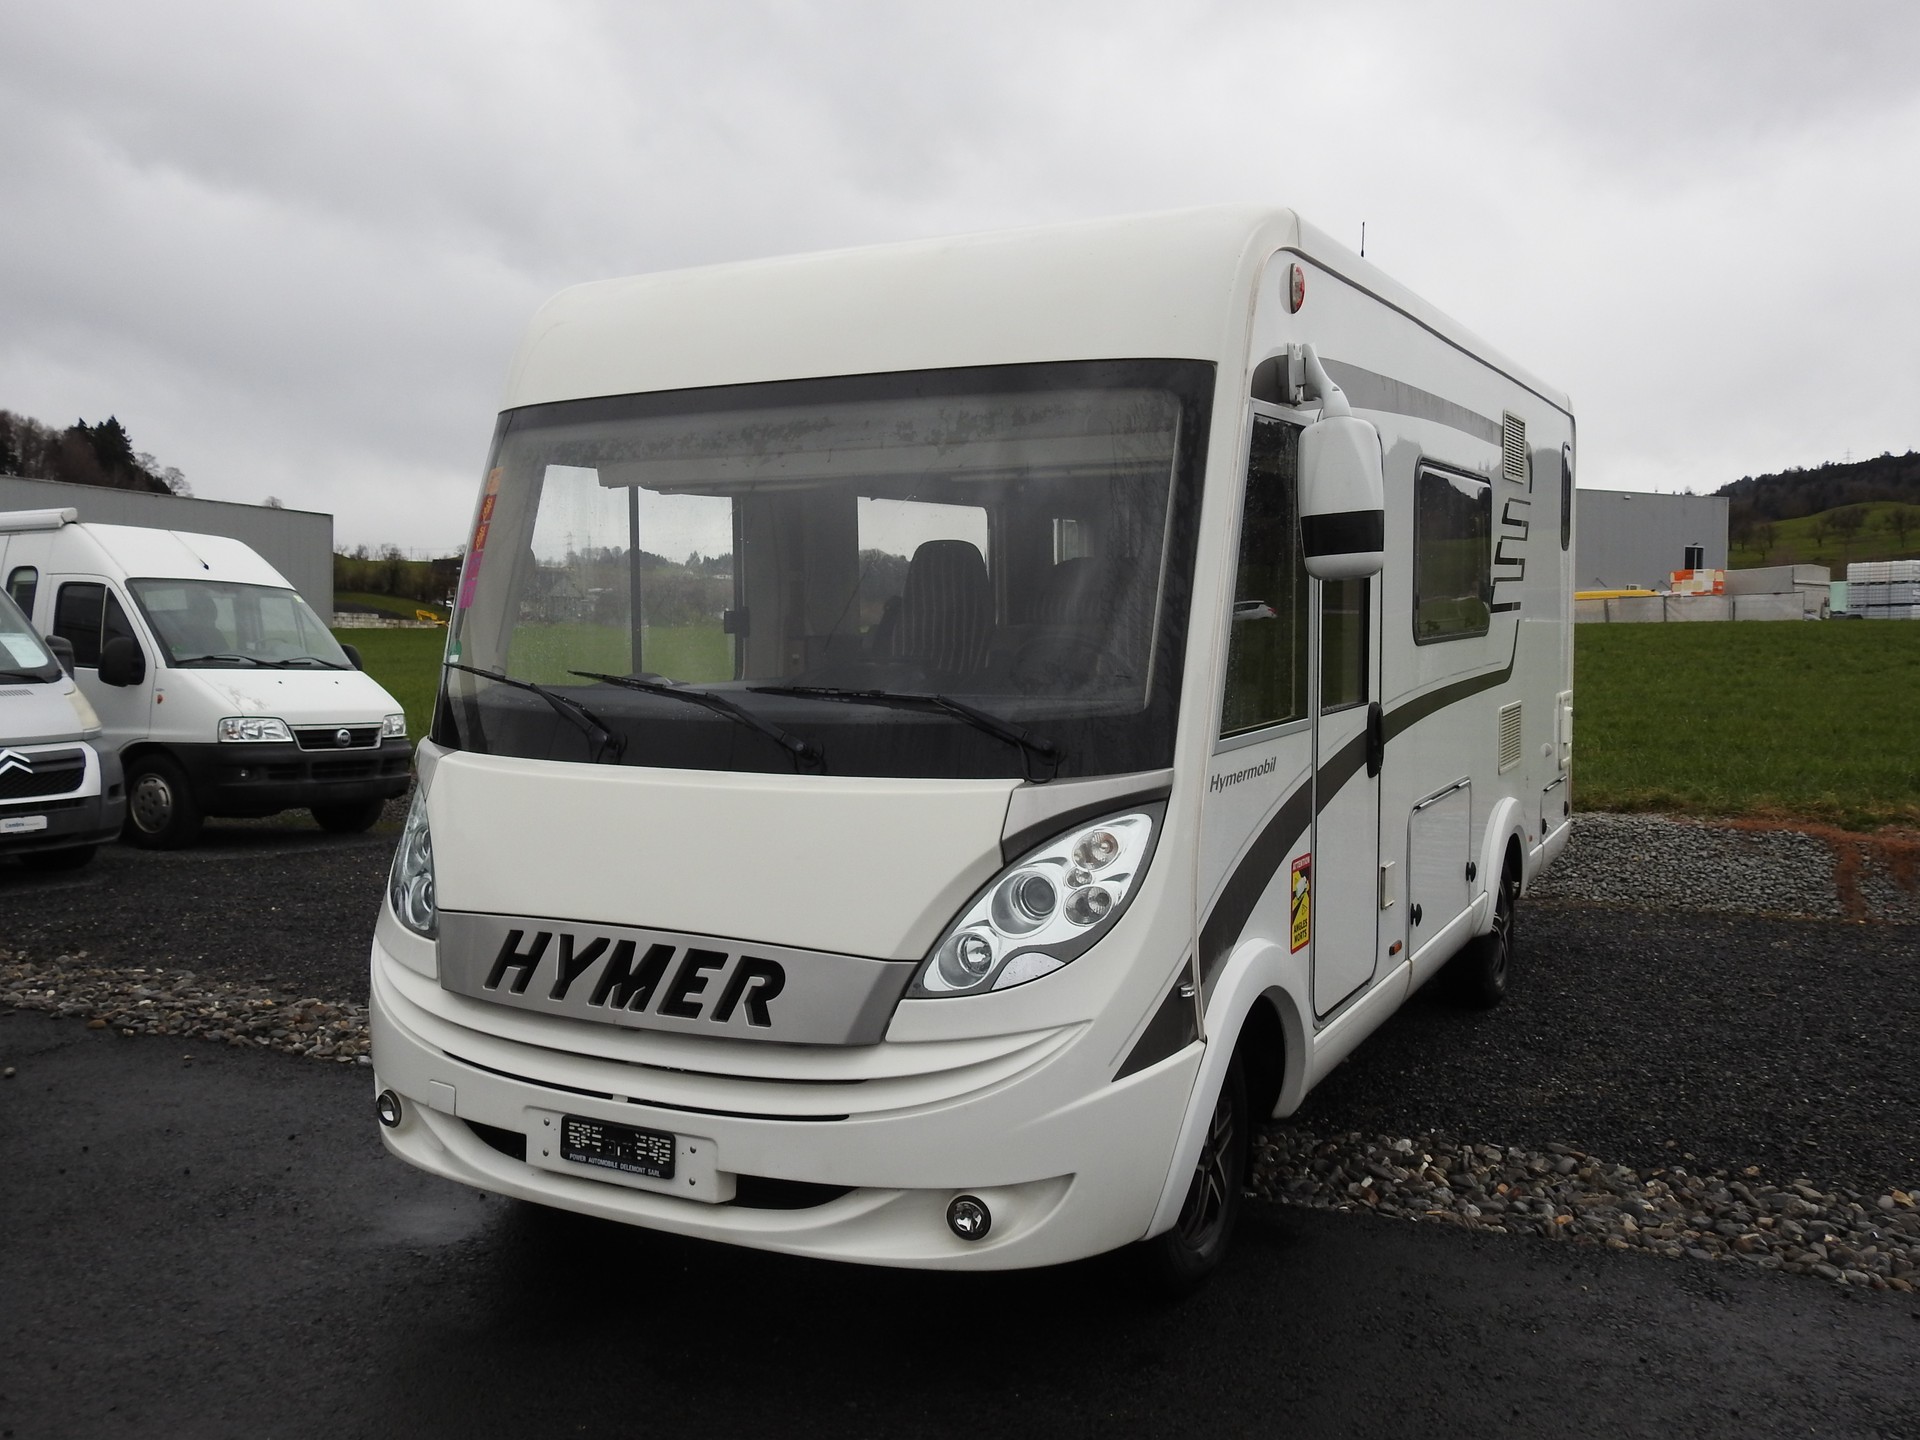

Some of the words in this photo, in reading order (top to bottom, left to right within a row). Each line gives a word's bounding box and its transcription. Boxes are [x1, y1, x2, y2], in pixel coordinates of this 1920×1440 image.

[1209, 756, 1277, 793] Hymermobil
[1293, 918, 1308, 933] ANGLES
[1294, 929, 1307, 942] MORTS
[482, 929, 786, 1028] HYMER
[569, 1153, 587, 1161] POWER
[588, 1157, 618, 1168] AUTOMOBILE
[620, 1162, 646, 1173] DELEMONT
[647, 1168, 661, 1178] SARL
